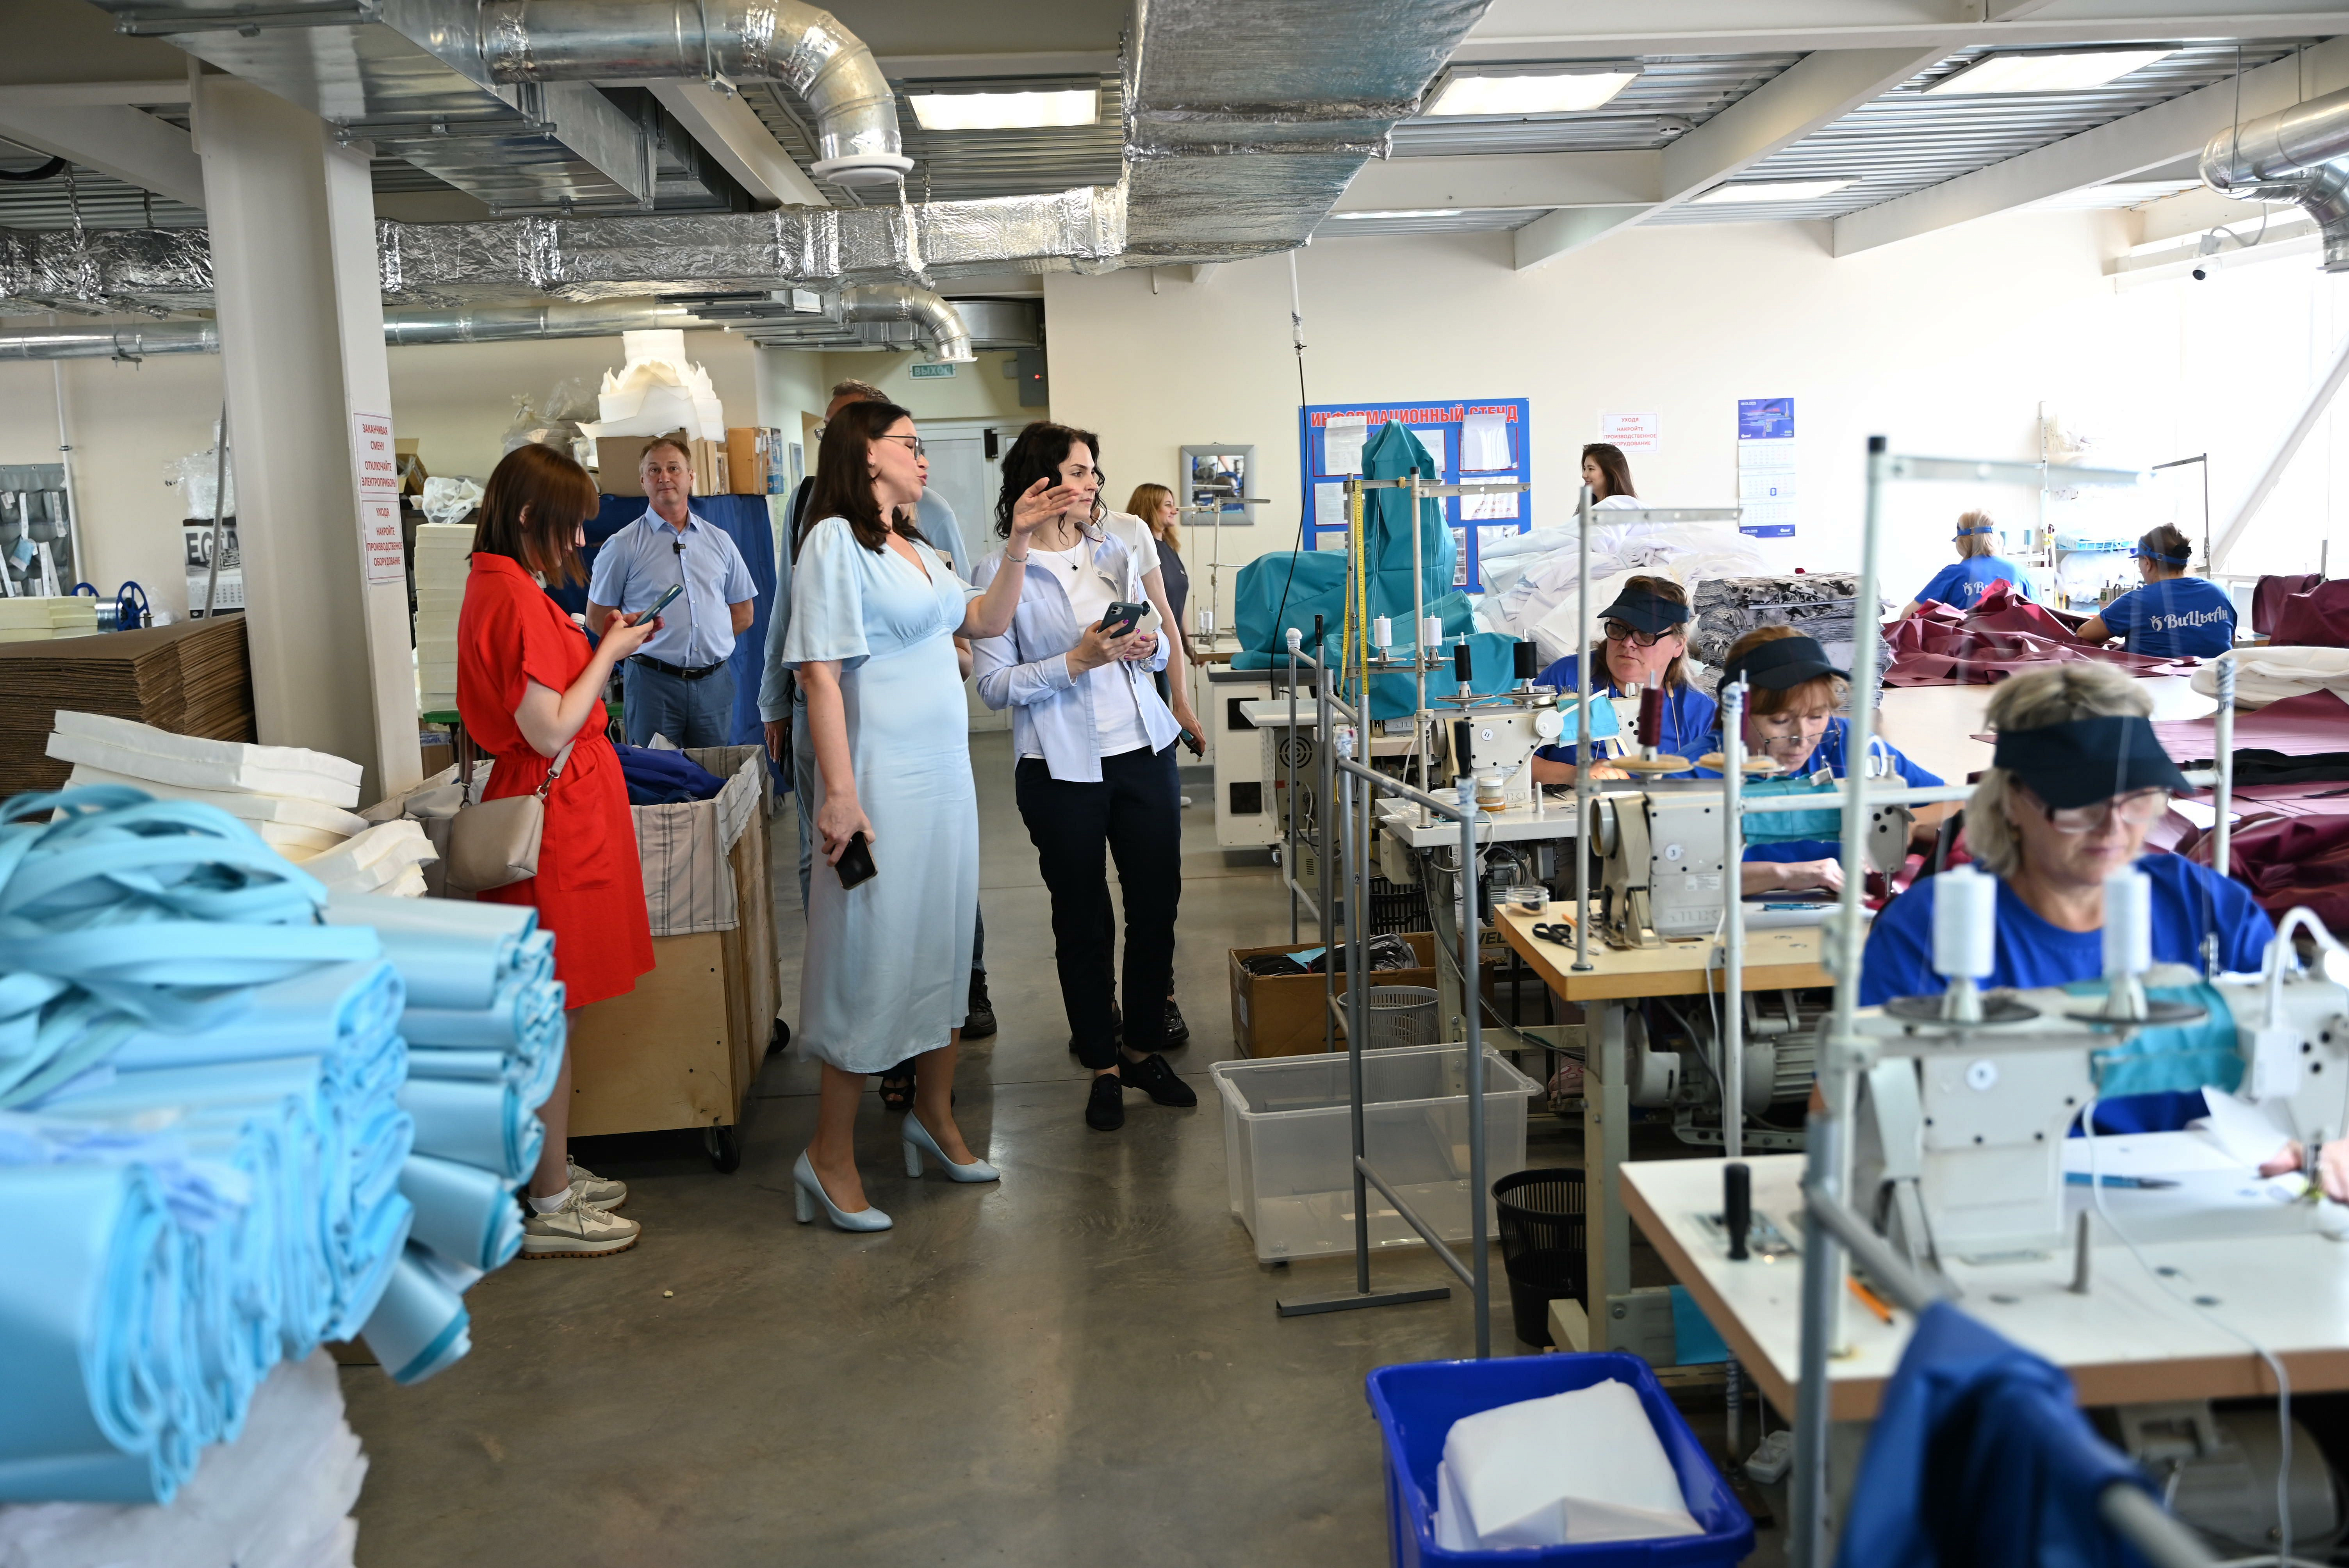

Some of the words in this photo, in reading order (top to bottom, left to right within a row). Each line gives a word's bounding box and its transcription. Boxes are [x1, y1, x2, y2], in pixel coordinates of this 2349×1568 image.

[914, 365, 952, 376] ВЫХОД
[362, 424, 388, 435] ЗАКАНЧИВАЯ
[371, 441, 384, 450] СМЕНУ
[365, 460, 392, 471] ОТКЛЮЧАЙТЕ
[362, 477, 396, 487] ЭЛЕКТРОПРИБОРЫ
[376, 508, 390, 518] УХОДЯ
[376, 525, 395, 536] НАКРОЙТЕ
[367, 542, 403, 552] ПРОИЗВОДСТВЕННОЕ
[374, 557, 401, 567] ОБОРУДОВАНИЕ
[1478, 932, 1506, 944] VEL
